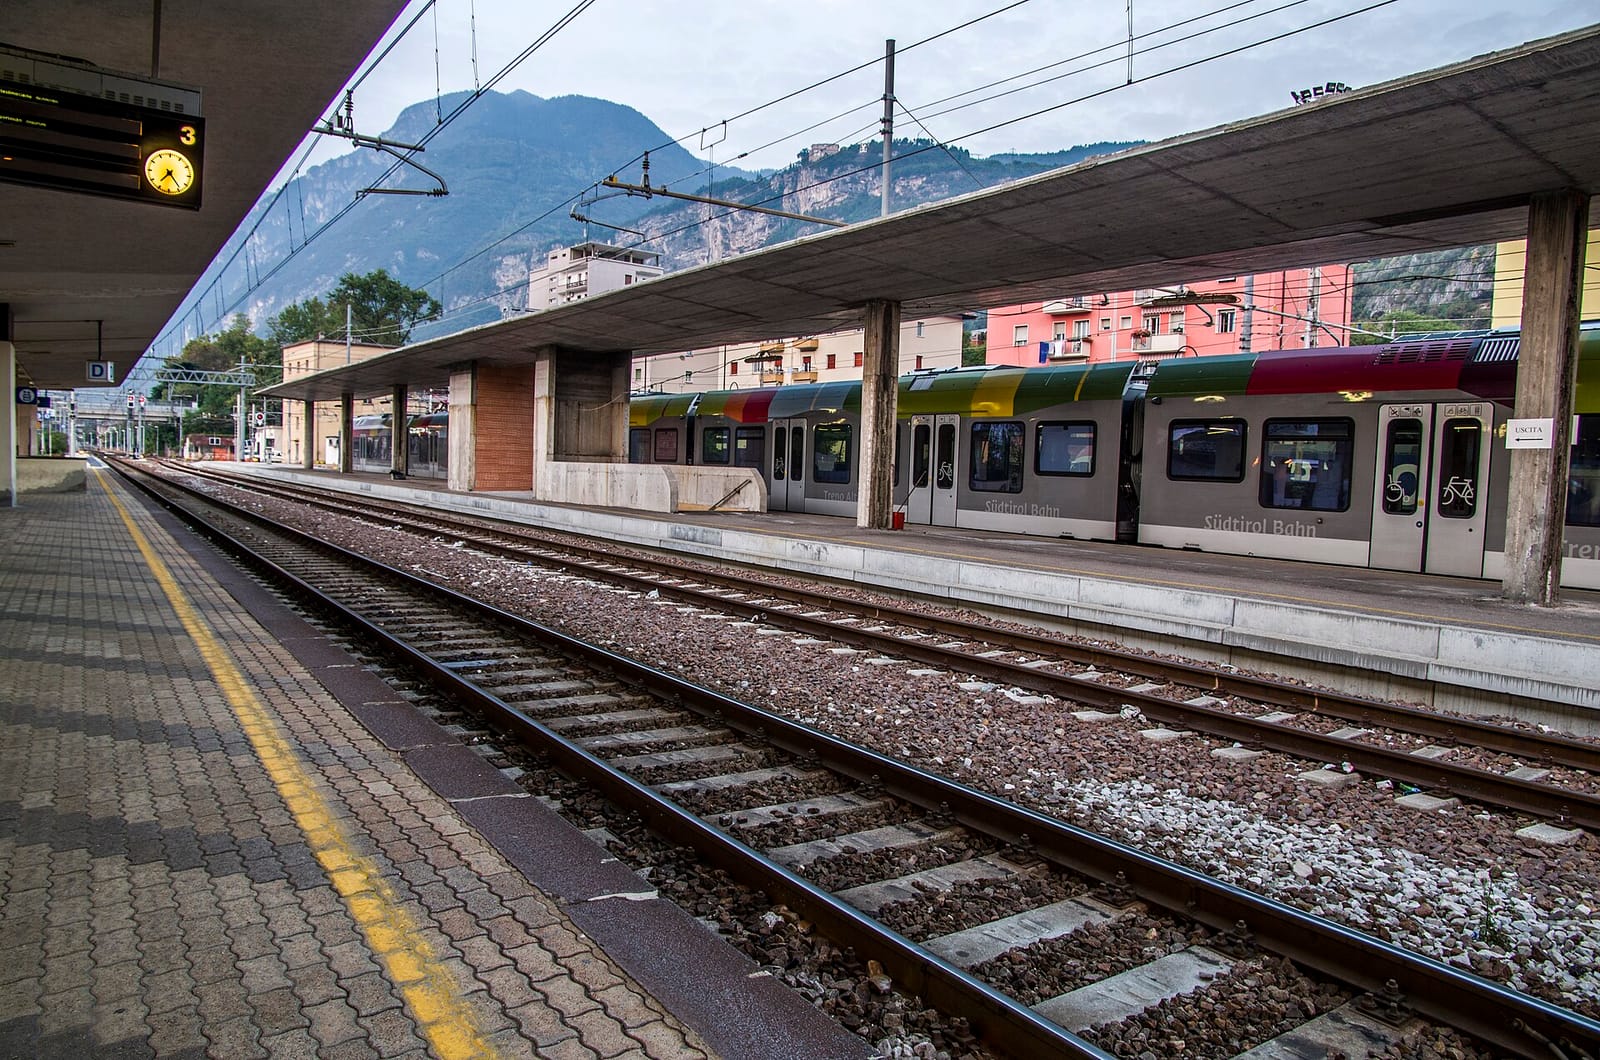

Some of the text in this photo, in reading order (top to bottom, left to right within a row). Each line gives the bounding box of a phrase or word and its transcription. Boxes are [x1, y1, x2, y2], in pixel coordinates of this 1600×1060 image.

[179, 125, 197, 145] 3
[91, 364, 104, 378] D
[823, 489, 845, 499] Treno
[985, 499, 1060, 519] Südtirol Bahn
[1203, 514, 1317, 538] Südtirol Bahn
